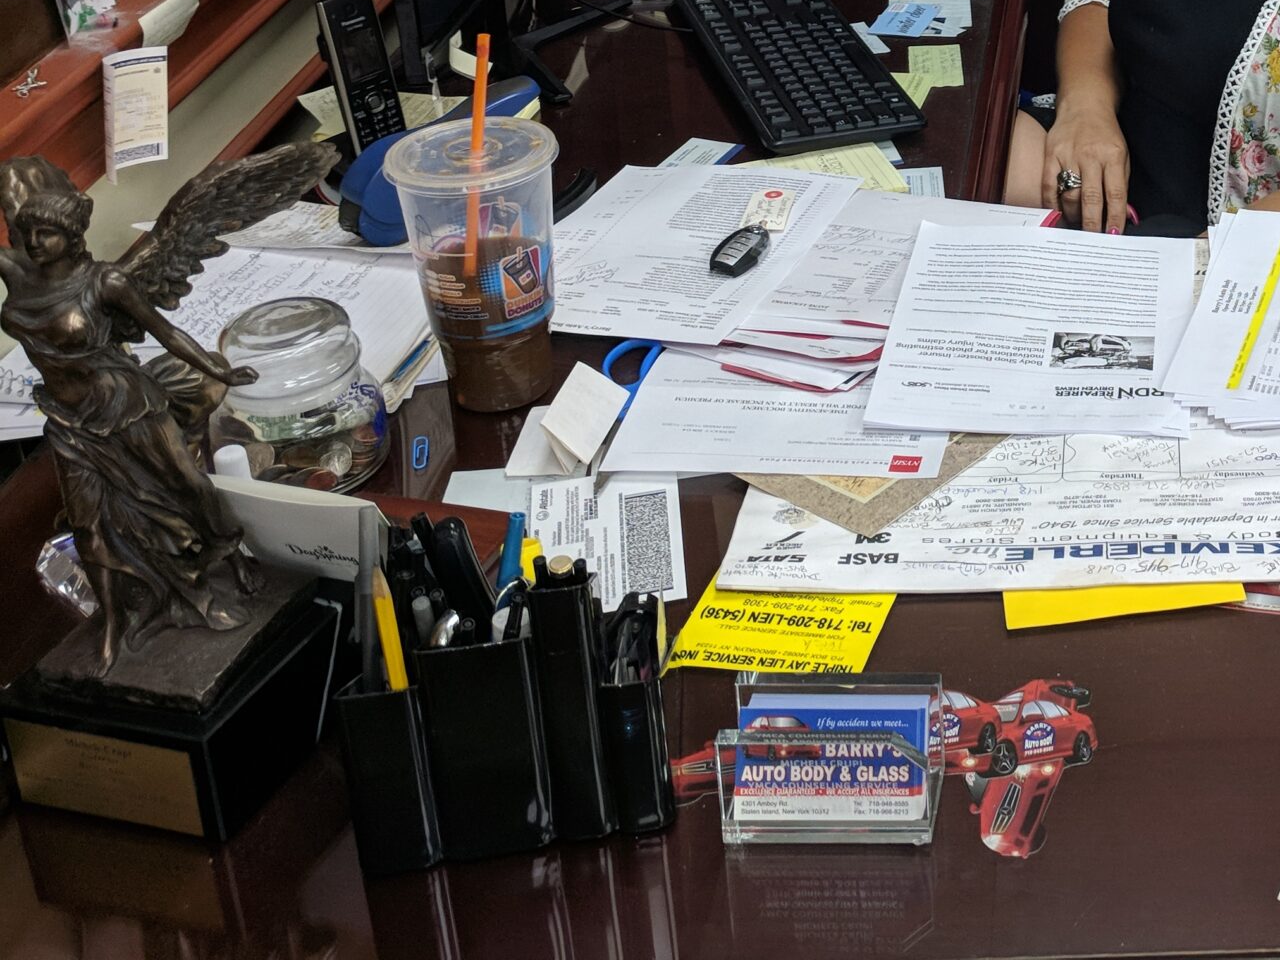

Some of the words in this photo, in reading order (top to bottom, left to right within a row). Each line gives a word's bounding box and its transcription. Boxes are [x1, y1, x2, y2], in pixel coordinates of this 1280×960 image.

[506, 295, 545, 319] DONUTS
[895, 343, 945, 351] estimating
[945, 345, 974, 353] photo
[917, 351, 952, 359] Insurer
[953, 353, 993, 362] Booster:
[990, 350, 1045, 359] motivations
[994, 356, 1018, 365] Shop
[1019, 358, 1043, 367] Body
[1055, 390, 1114, 398] REPAIRER
[1117, 387, 1165, 400] RDN
[891, 459, 920, 467] NYSIF
[1099, 472, 1145, 480] Thursday
[1213, 470, 1265, 478] Wednesday
[986, 475, 1020, 485] Friday
[1082, 518, 1121, 527] Since
[1122, 516, 1173, 526] Service
[1176, 512, 1253, 524] Dependable
[1256, 514, 1269, 522] in
[920, 537, 1016, 545] Stores
[1028, 532, 1178, 544] Equipment
[746, 554, 807, 563] SATA
[837, 552, 900, 565] BASF
[742, 598, 821, 613] 718-209-1308
[824, 605, 845, 615] Fax:
[700, 605, 746, 621] (5436)
[747, 613, 844, 629] 718-209-LIEN
[848, 621, 873, 634] Tel:
[702, 649, 756, 666] SERVICE,
[756, 656, 785, 669] LIEN
[786, 659, 812, 671] JAY
[826, 718, 836, 728] by
[836, 718, 869, 728] accident
[870, 720, 883, 728] we
[1024, 738, 1040, 749] AUTO
[1039, 733, 1055, 746] BODY
[825, 742, 903, 758] BARRY'S
[741, 765, 786, 782] AUTO
[790, 765, 835, 782] BODY
[839, 766, 852, 782] &
[856, 766, 910, 782] GLASS
